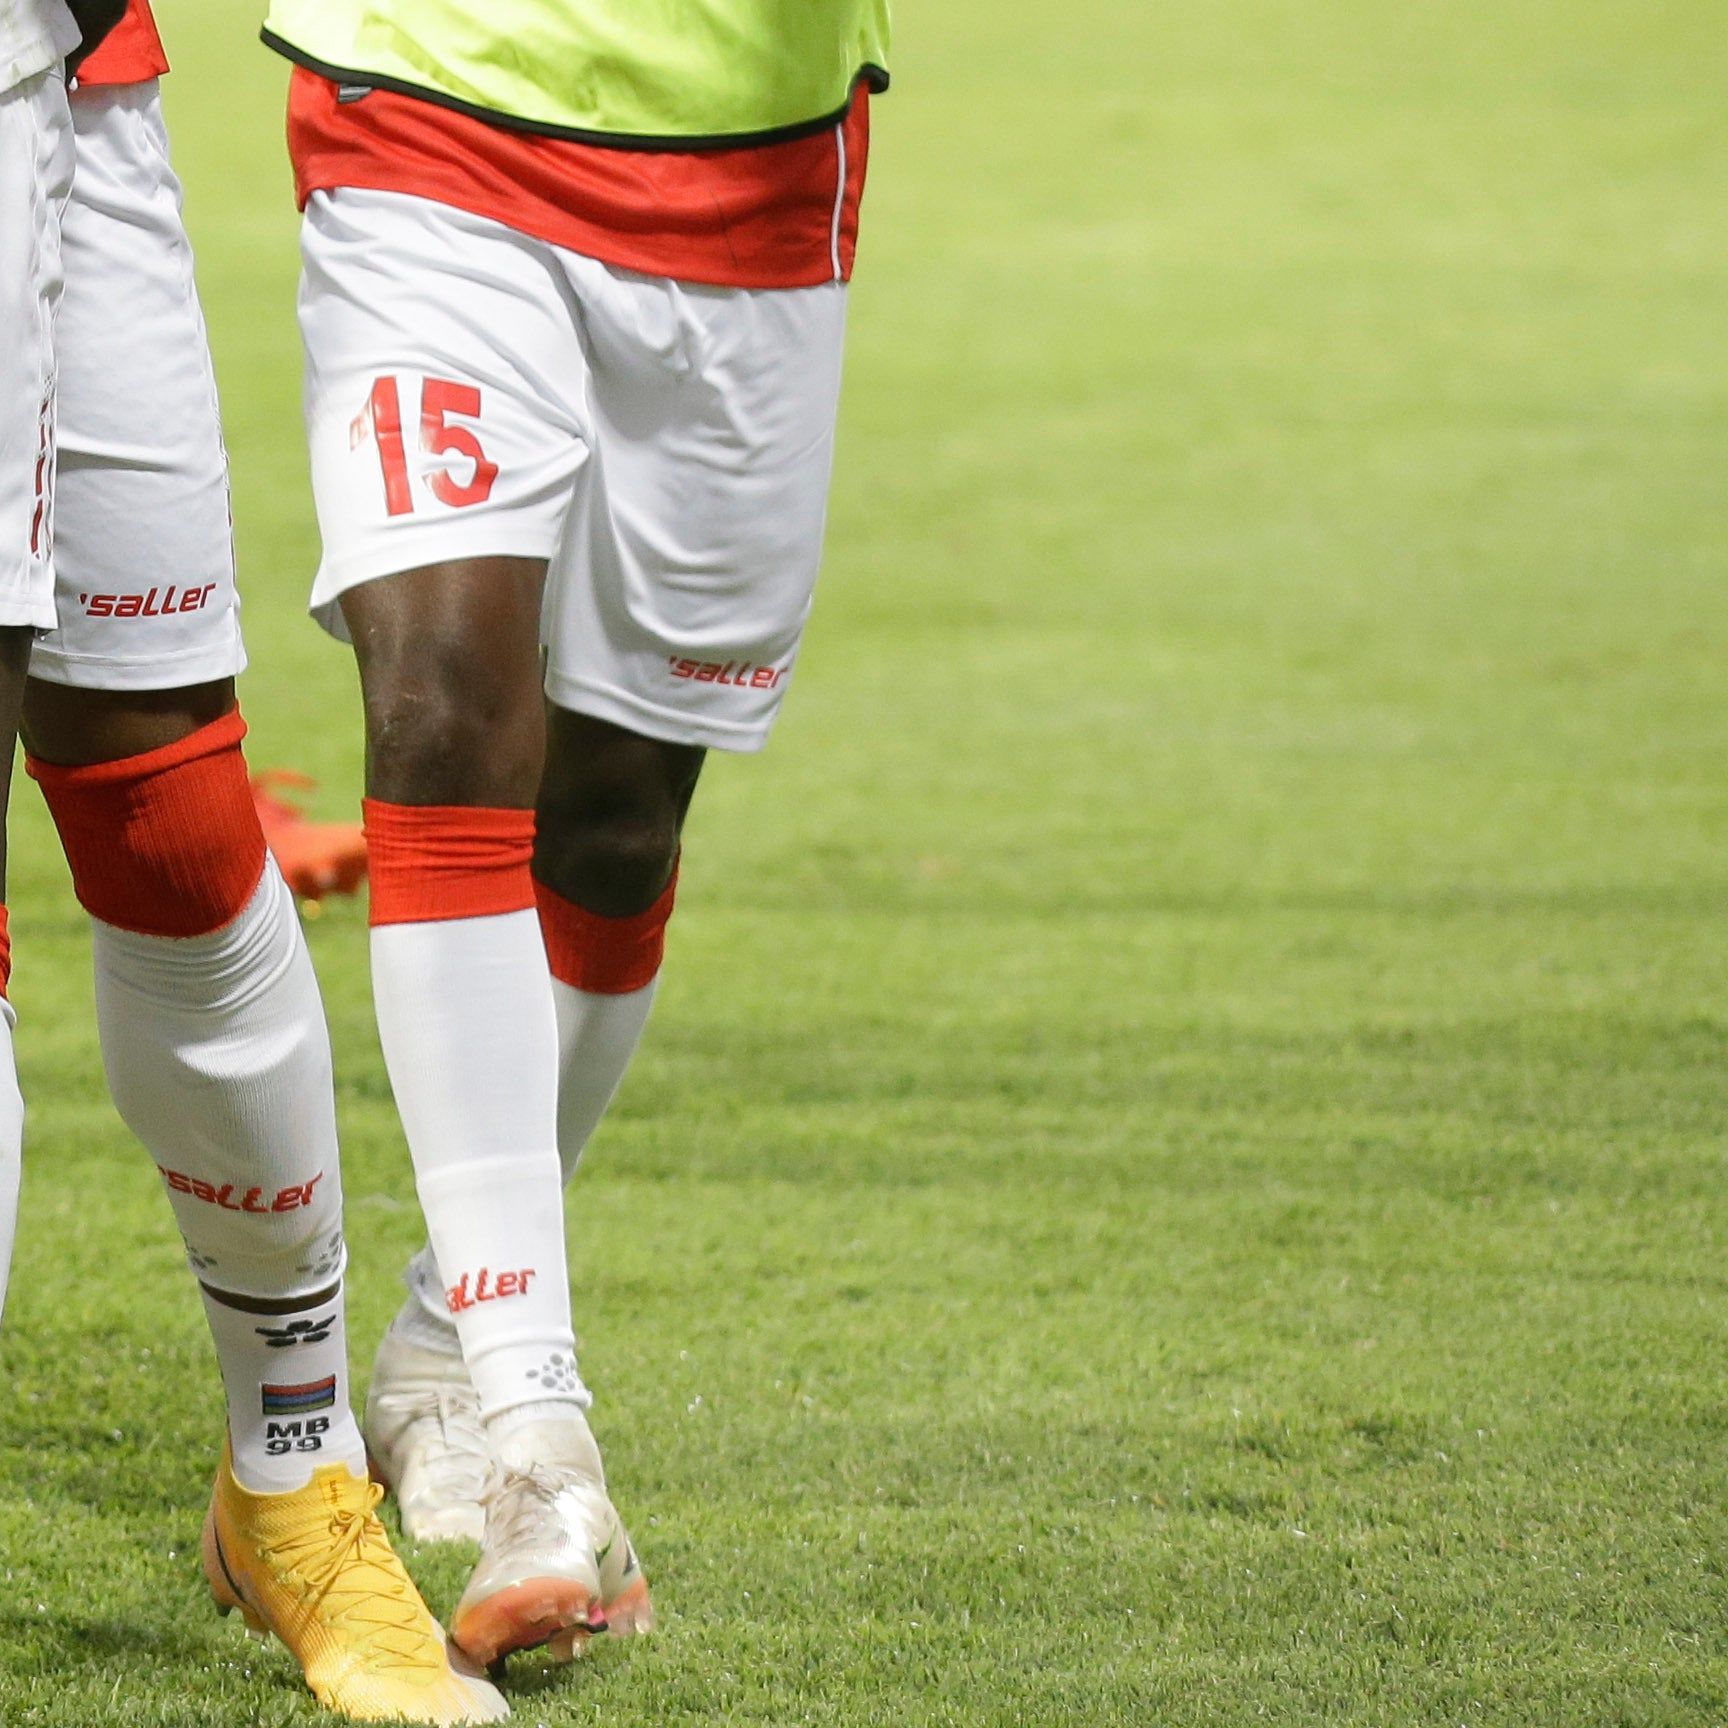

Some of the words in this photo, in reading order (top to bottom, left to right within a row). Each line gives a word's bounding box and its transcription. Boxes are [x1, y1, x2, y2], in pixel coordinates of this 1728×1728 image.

[349, 375, 499, 517] 15
[266, 1415, 330, 1439] MB
[265, 1435, 322, 1455] 99
